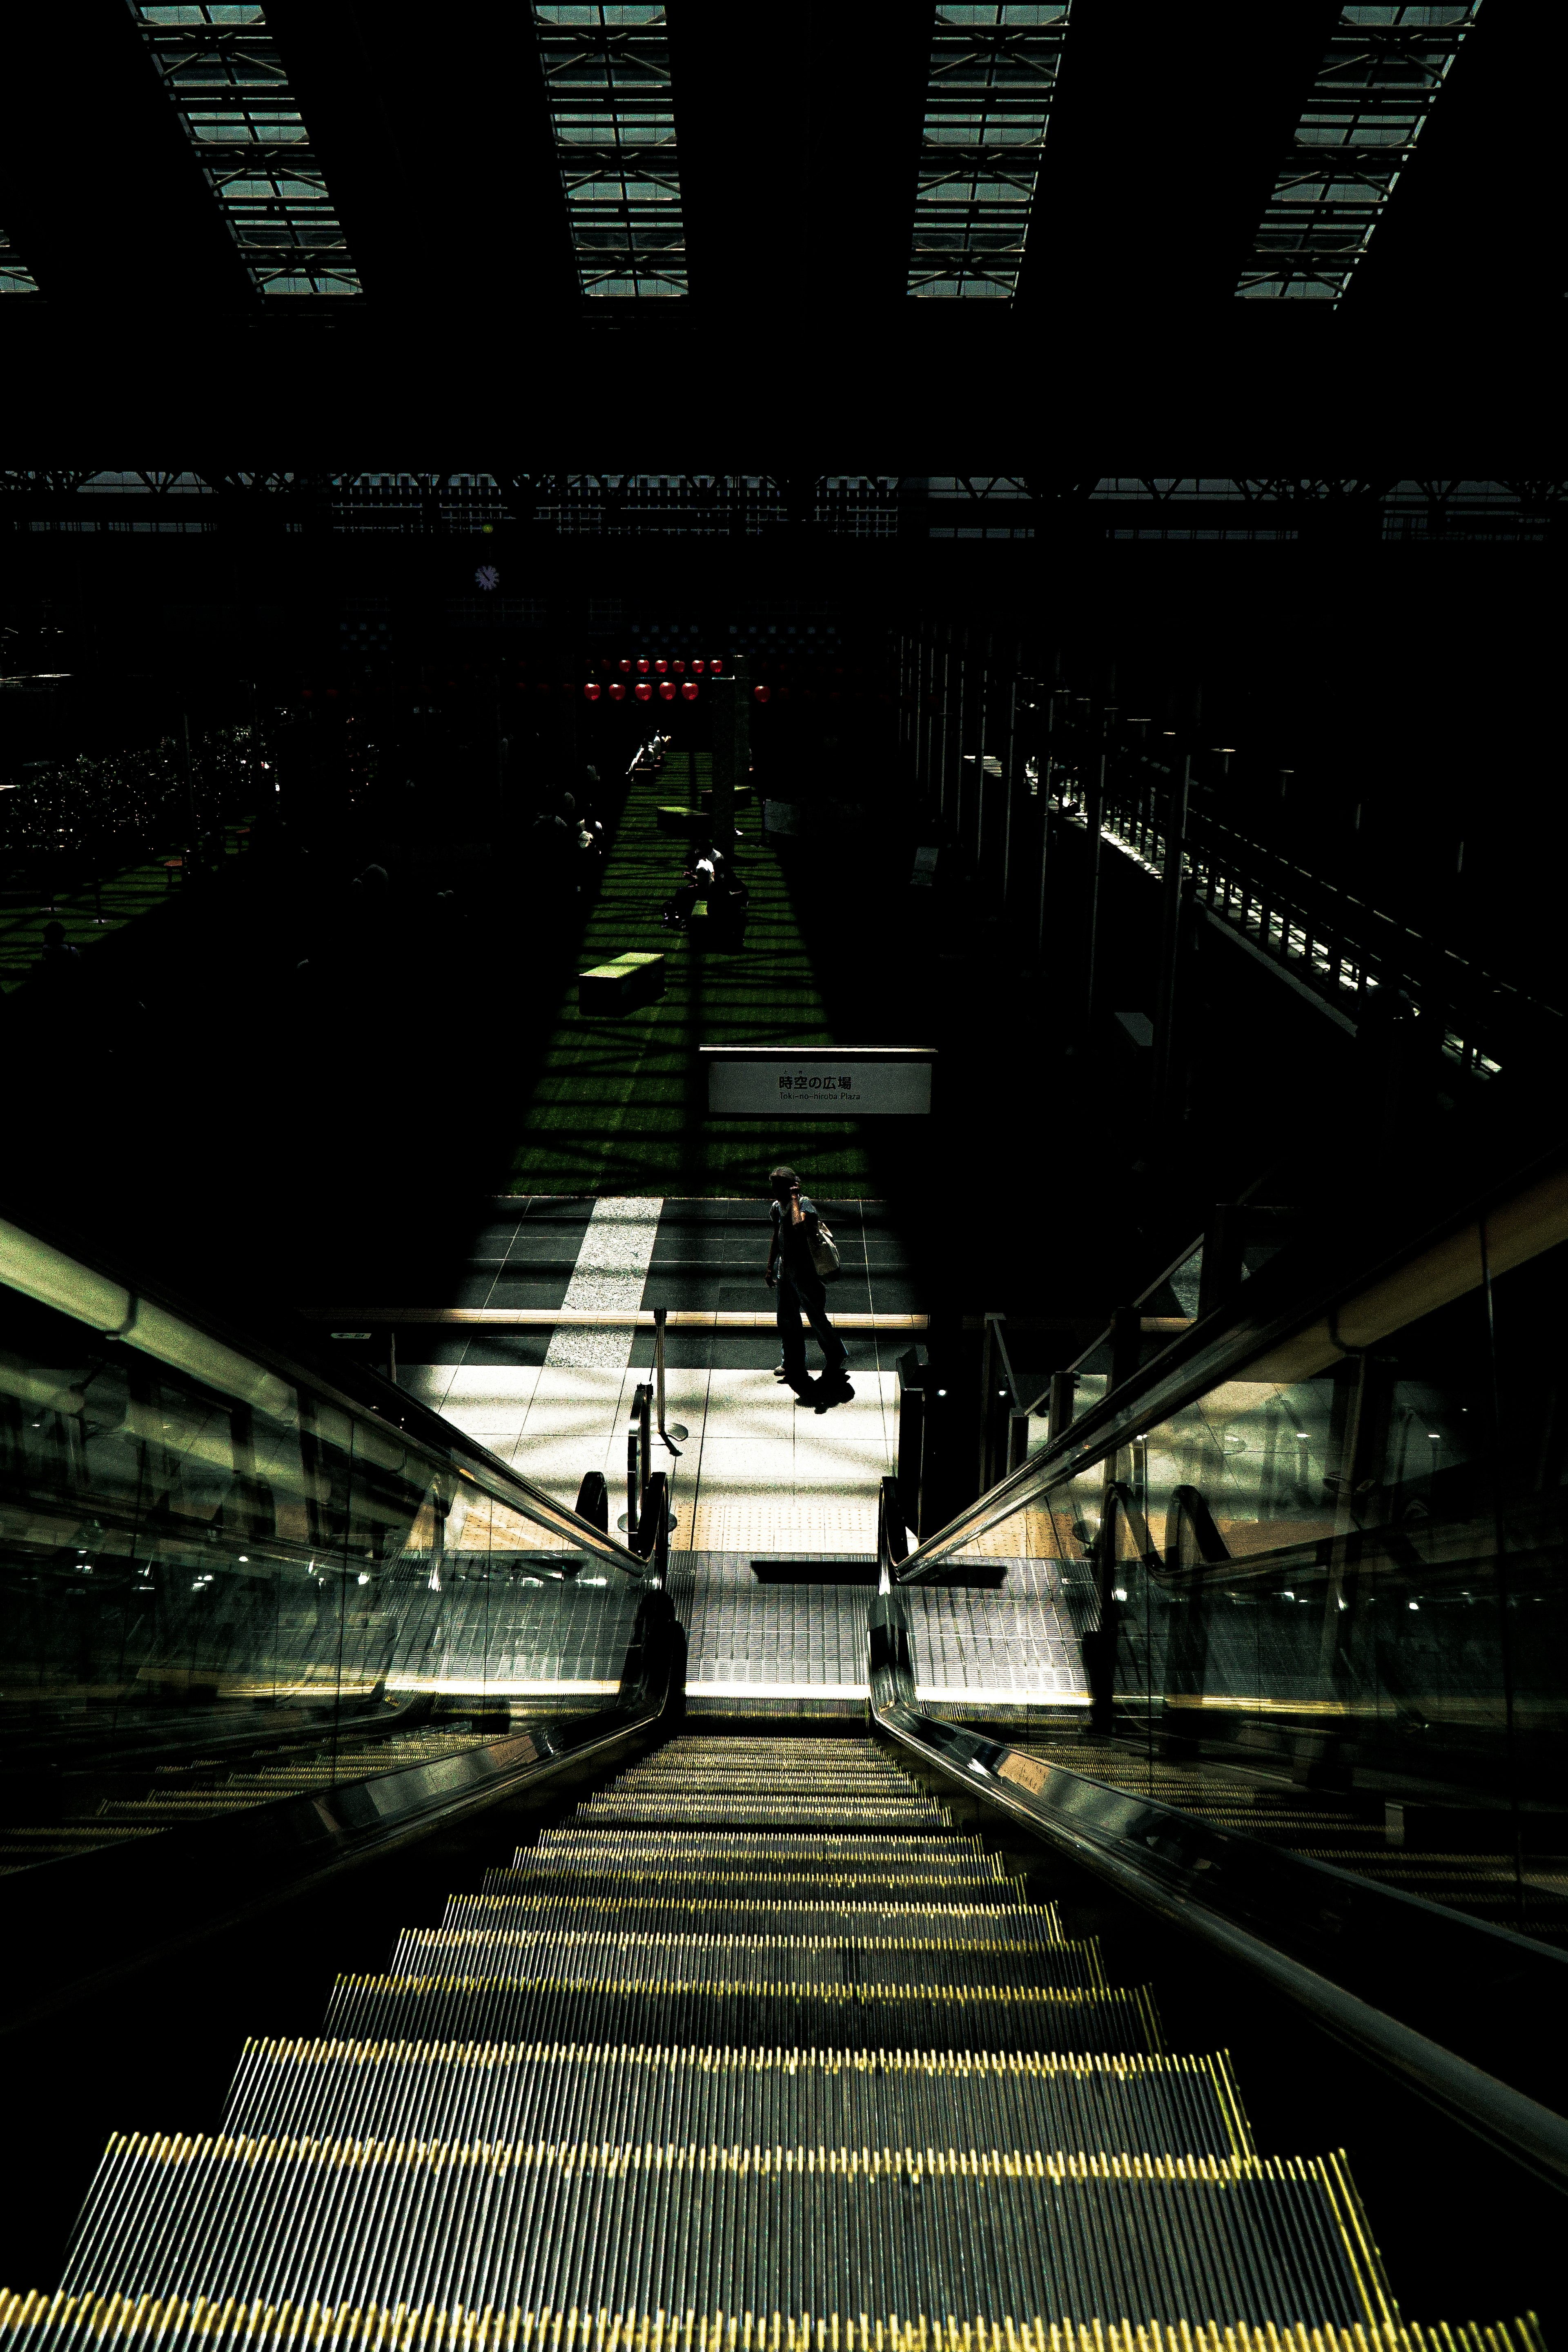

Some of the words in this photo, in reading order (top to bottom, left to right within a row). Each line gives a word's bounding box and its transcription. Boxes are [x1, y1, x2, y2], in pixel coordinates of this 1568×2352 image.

[779, 1076, 852, 1090] 時空の広場
